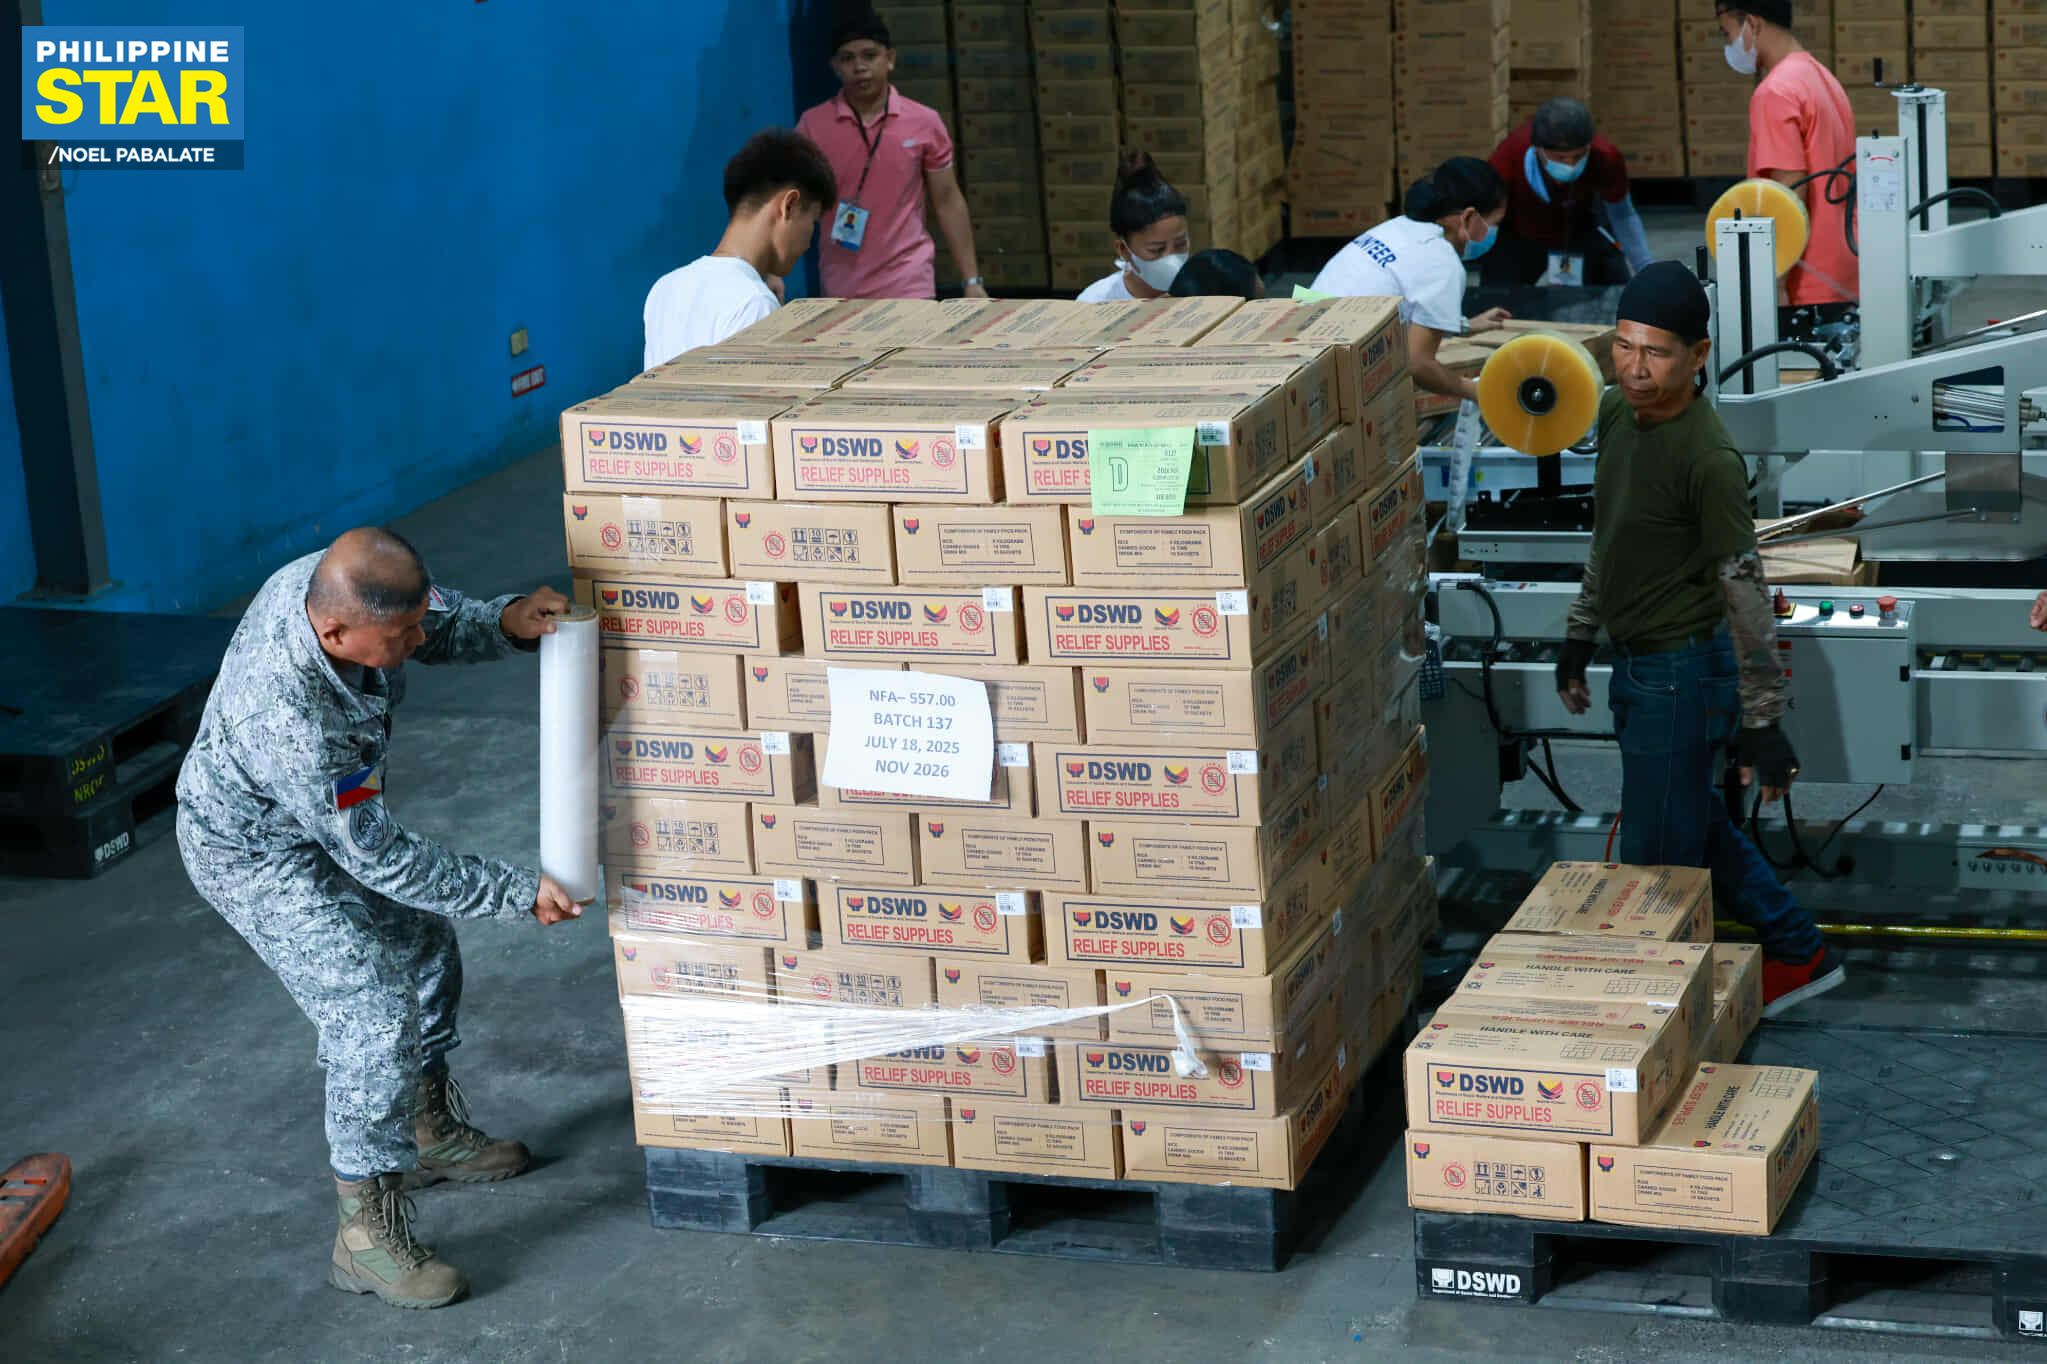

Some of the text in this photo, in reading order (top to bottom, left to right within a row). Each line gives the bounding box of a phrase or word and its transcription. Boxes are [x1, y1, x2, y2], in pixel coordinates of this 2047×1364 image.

[609, 431, 668, 451] DSWD
[822, 437, 883, 457] DSWD
[1056, 440, 1089, 459] DS
[589, 459, 694, 478] RELIEF SUPPLIES
[801, 466, 911, 484] RELIEF SUPPLIES
[1034, 470, 1080, 486] RELIEF
[621, 589, 680, 610] DSWD
[851, 600, 912, 620] DSWD
[1078, 604, 1142, 624] DSWD
[601, 616, 705, 637] RELIEF SUPPLIES
[830, 630, 939, 647] RELIEF SUPPLIES
[1056, 635, 1170, 651] RELIEF SUPPLIES
[910, 692, 956, 707] 557.00
[873, 712, 952, 730] BATCH 137
[635, 739, 694, 760] DSWD
[864, 735, 960, 754] JULY 18, 2025
[615, 766, 720, 786] RELIEF SUPPLIES
[875, 759, 949, 778] NOV 2026
[1088, 761, 1151, 781] DSWD
[1066, 790, 1180, 808] RELIEF SUPPLIES
[651, 883, 708, 904] DSWD
[867, 896, 927, 917] DSWD
[1095, 911, 1158, 931] DSWD
[847, 923, 954, 944] RELIEF SUPPLIES
[1073, 938, 1185, 958] RELIEF SUPPLIES
[1525, 963, 1637, 976] HANDLE WITH CARE
[1479, 1025, 1594, 1039] HANDLE WITH CARE
[1108, 1052, 1170, 1073] DSWD
[864, 1066, 972, 1086] RELIEF SUPPLIES
[1459, 1073, 1525, 1096] DSWD
[1086, 1079, 1197, 1100] RELIEF SUPPLIES
[1436, 1099, 1553, 1123] RELIEF SUPPLIES
[1456, 1270, 1521, 1294] DSWD
